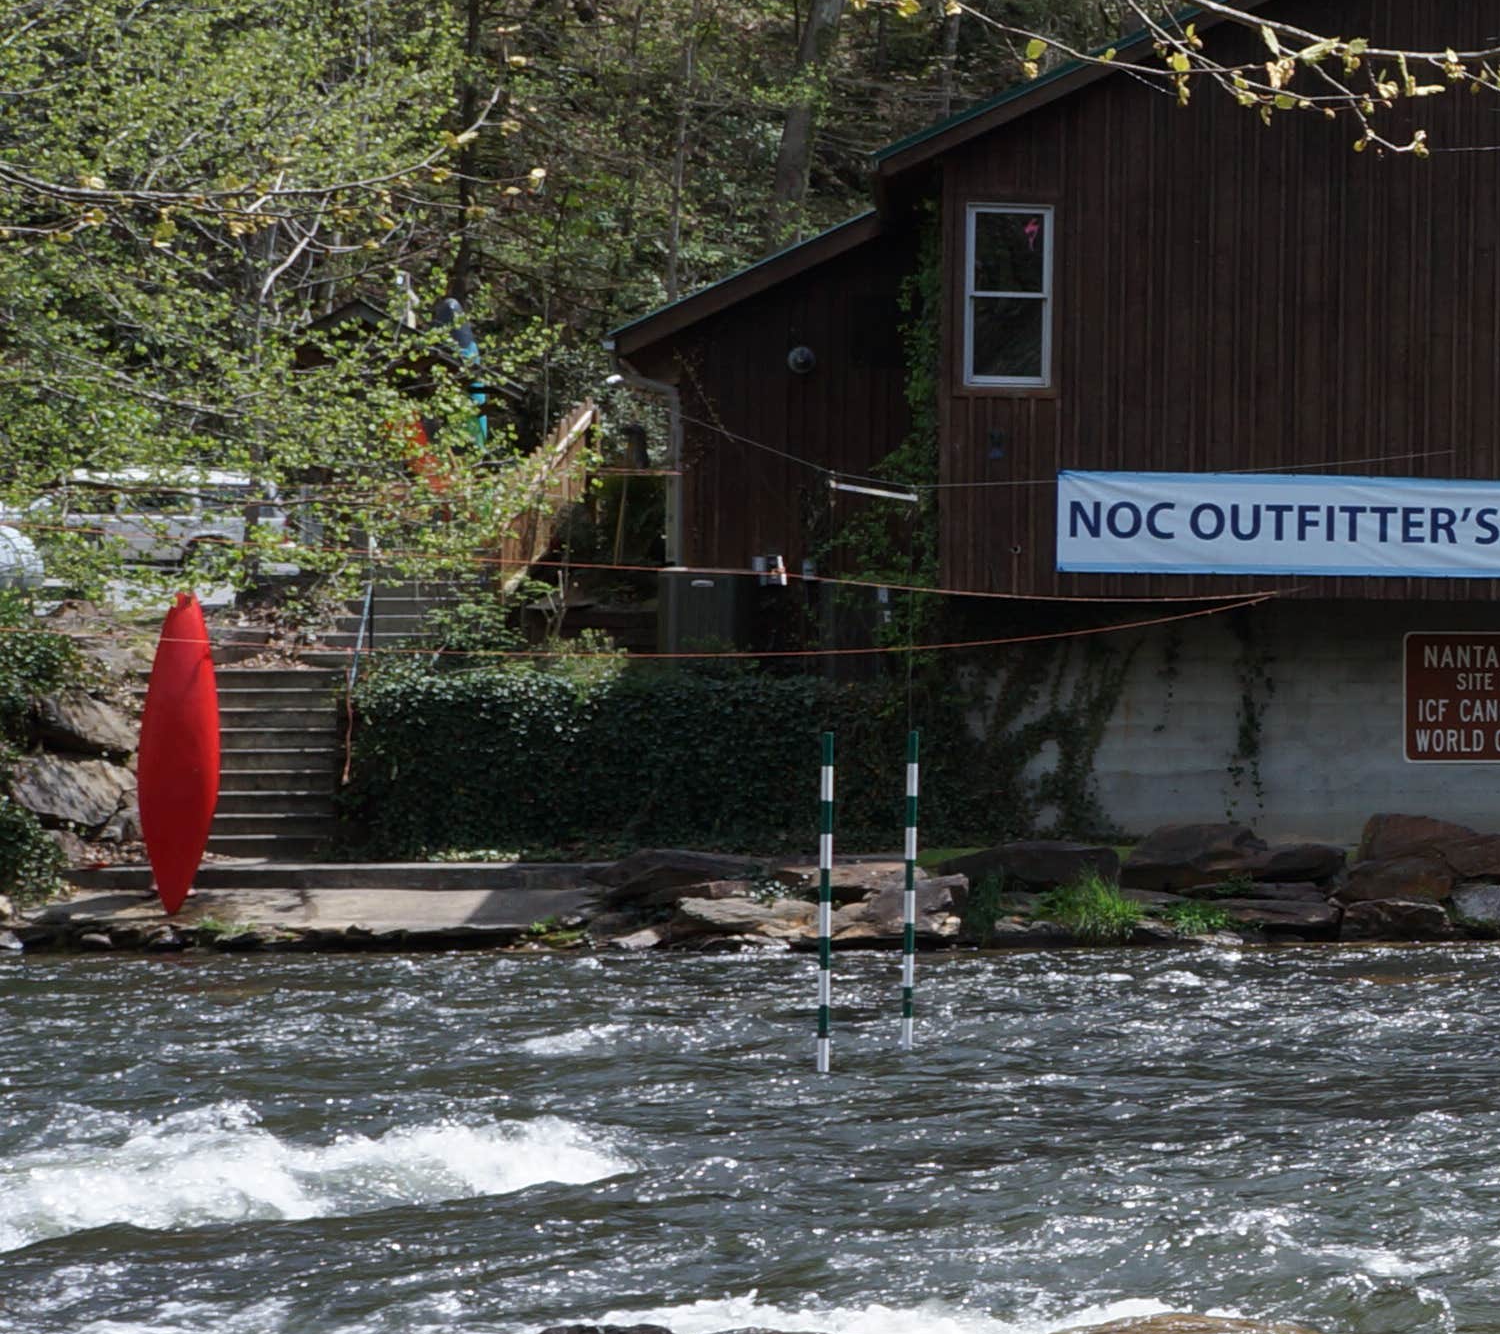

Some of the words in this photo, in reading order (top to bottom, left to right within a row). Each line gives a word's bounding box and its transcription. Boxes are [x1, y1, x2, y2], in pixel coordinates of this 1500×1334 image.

[1069, 501, 1176, 540] NOC
[1189, 503, 1500, 545] OUTFITTER'S
[1456, 673, 1494, 691] SITE
[1418, 699, 1449, 722] ICF
[1415, 729, 1485, 753] WORLD
